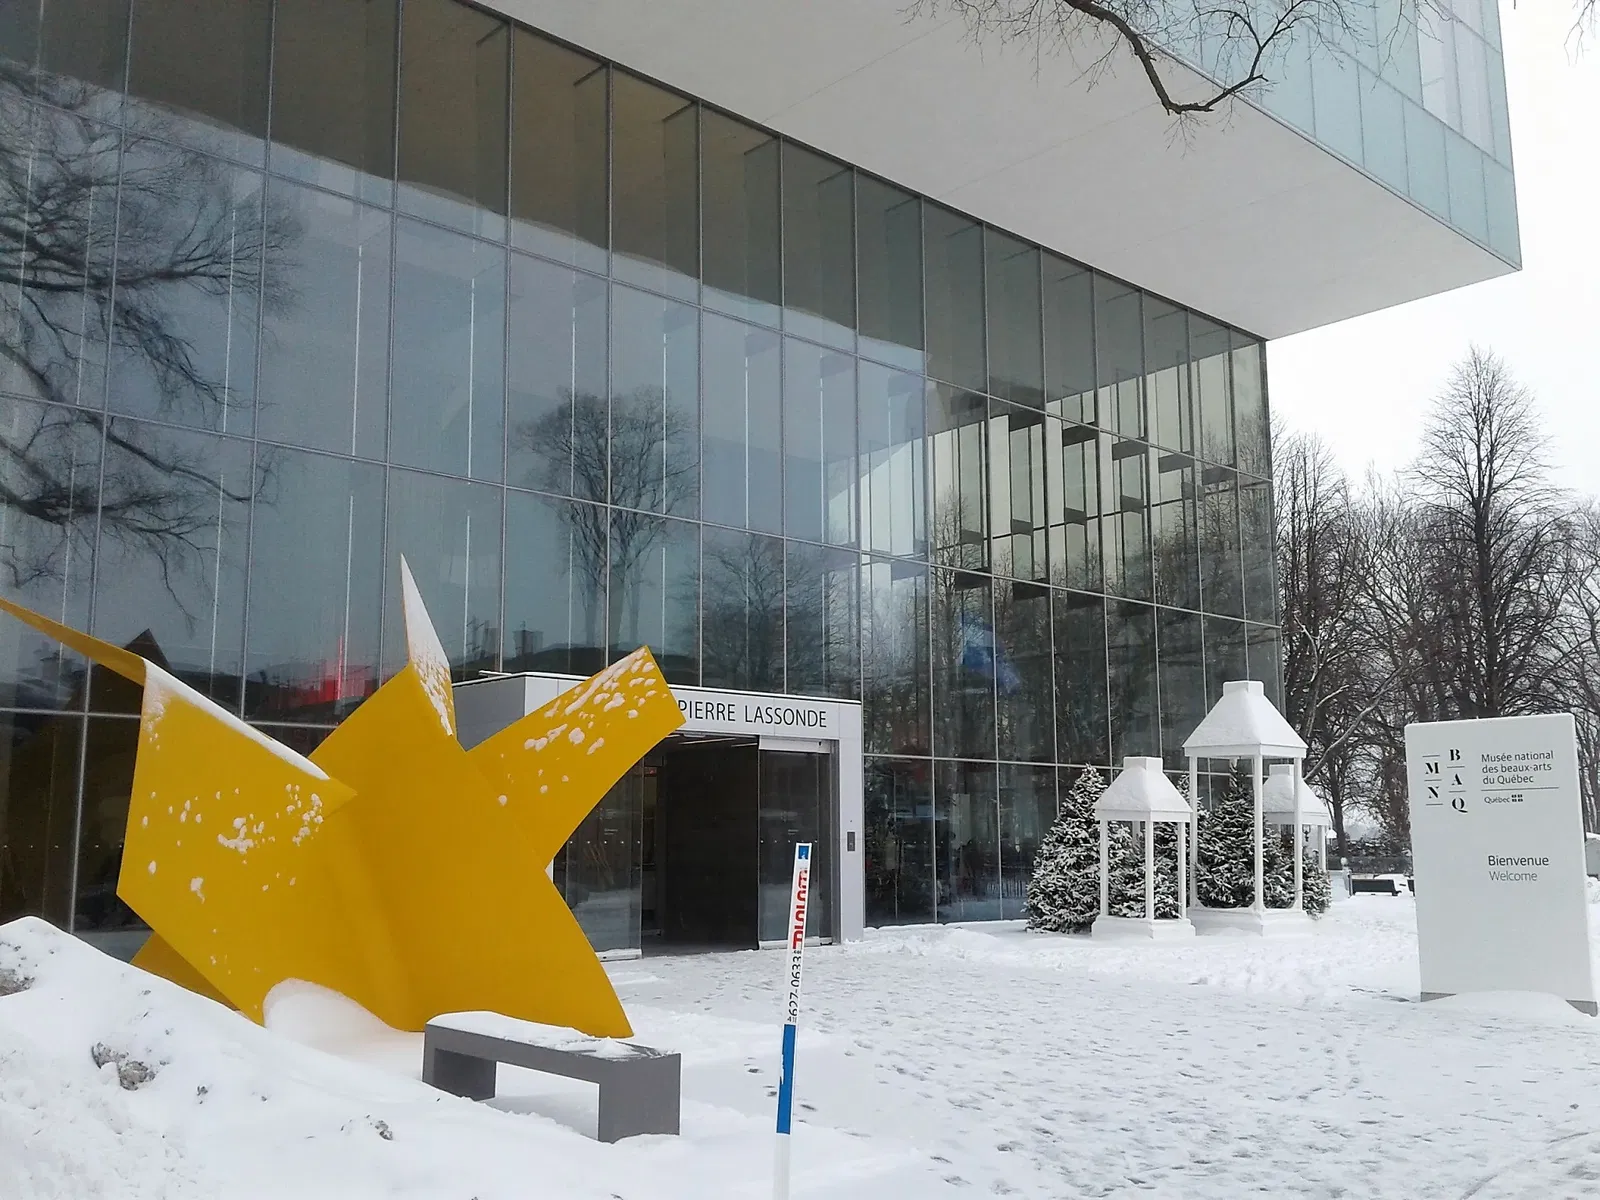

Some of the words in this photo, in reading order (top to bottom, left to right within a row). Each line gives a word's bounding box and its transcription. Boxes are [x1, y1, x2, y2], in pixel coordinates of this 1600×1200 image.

[678, 699, 736, 722] PIERRE
[745, 705, 827, 728] LASSONDE
[1481, 753, 1512, 762] Musée
[1514, 750, 1554, 761] national
[1482, 764, 1499, 774] des
[1500, 763, 1552, 773] beaux-arts
[1483, 775, 1495, 785] du
[1497, 774, 1535, 785] Québec
[1484, 796, 1511, 804] Québec
[1488, 855, 1550, 866] Bienvenue
[1489, 870, 1538, 881] Welcome
